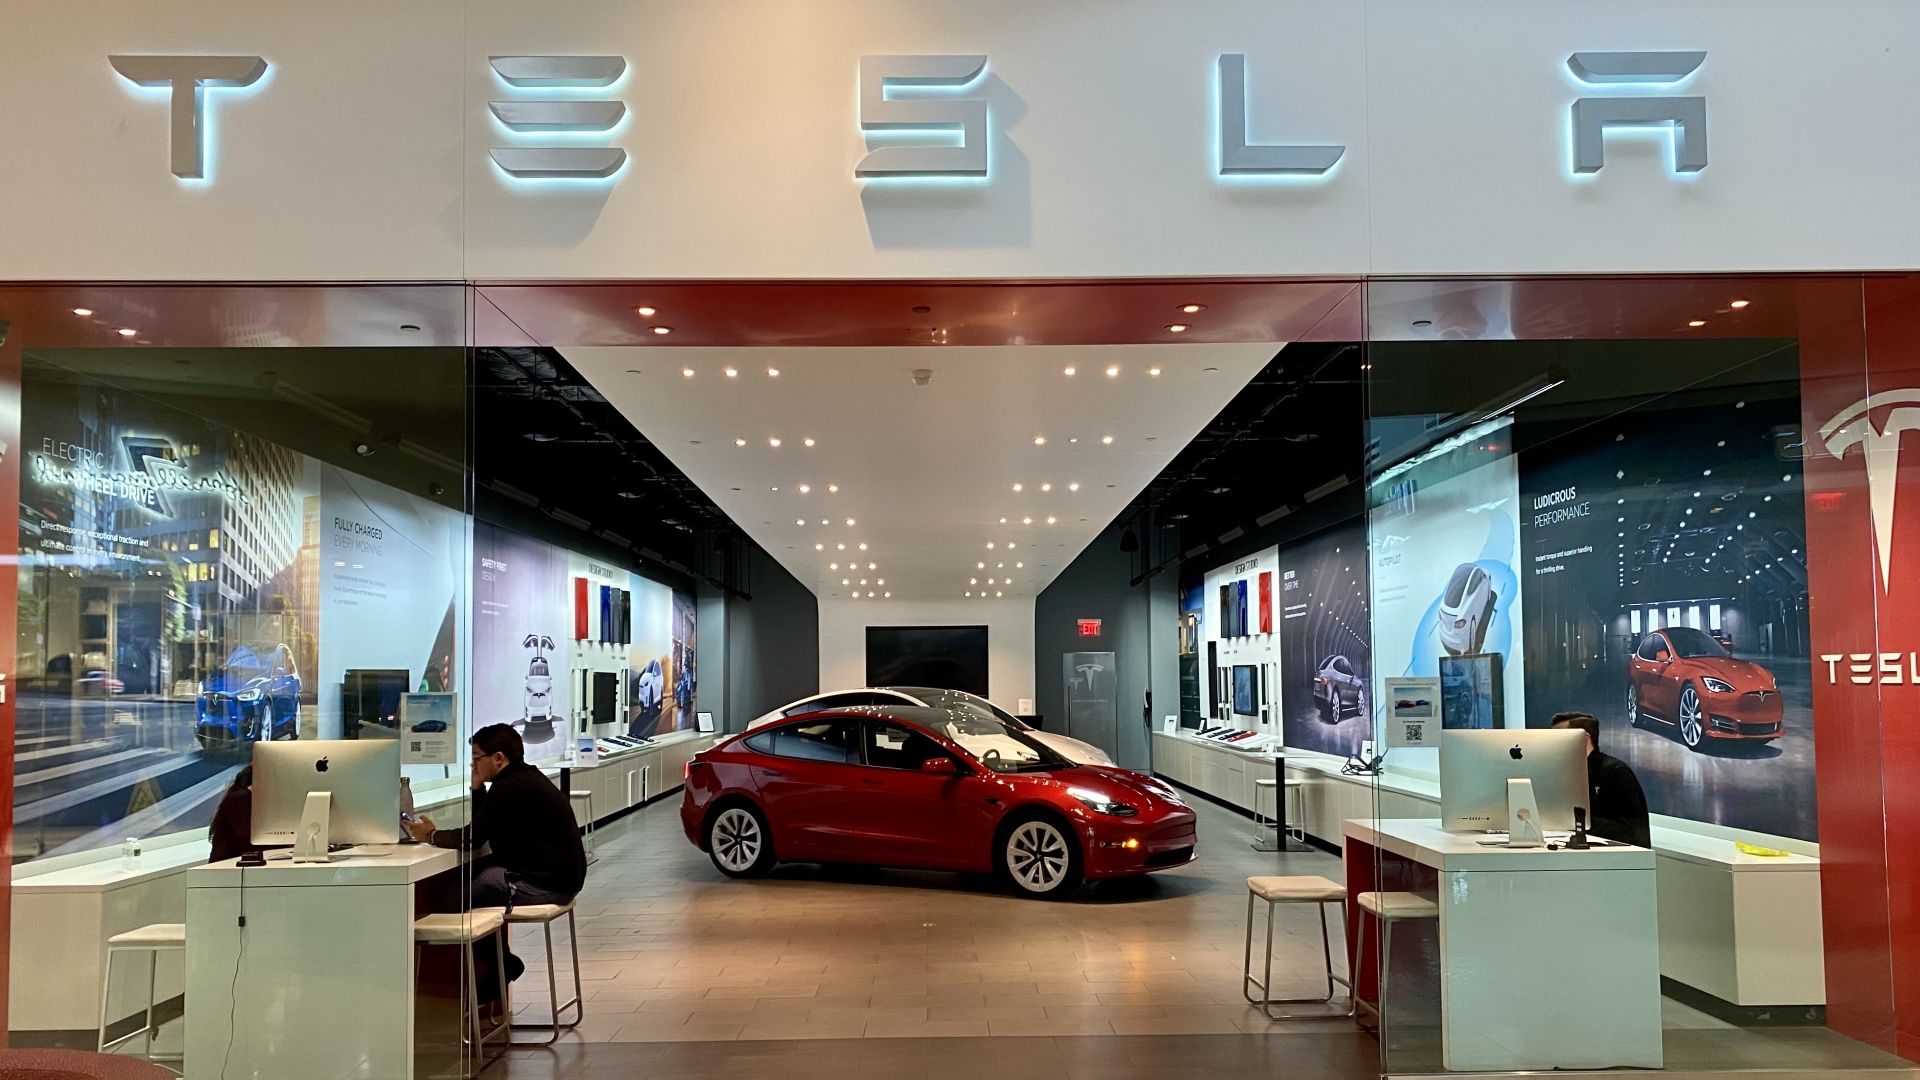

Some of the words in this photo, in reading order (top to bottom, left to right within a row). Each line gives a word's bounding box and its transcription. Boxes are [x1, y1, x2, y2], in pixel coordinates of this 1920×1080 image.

[107, 50, 1708, 180] TESLA
[43, 437, 104, 470] ELECTRIC
[121, 482, 156, 506] DRIVE
[1533, 486, 1576, 510] LUDICROUS
[1534, 501, 1591, 528] PERFORMANCE
[41, 520, 58, 532] Direct
[87, 530, 119, 543] exceptional
[118, 535, 139, 546] traction
[139, 539, 149, 548] and
[334, 517, 354, 532] FULLY
[354, 522, 383, 540] CHARGED
[334, 535, 355, 550] EVERY
[355, 540, 383, 556] MORNING
[1556, 550, 1564, 558] and
[1082, 623, 1098, 635] EXIT
